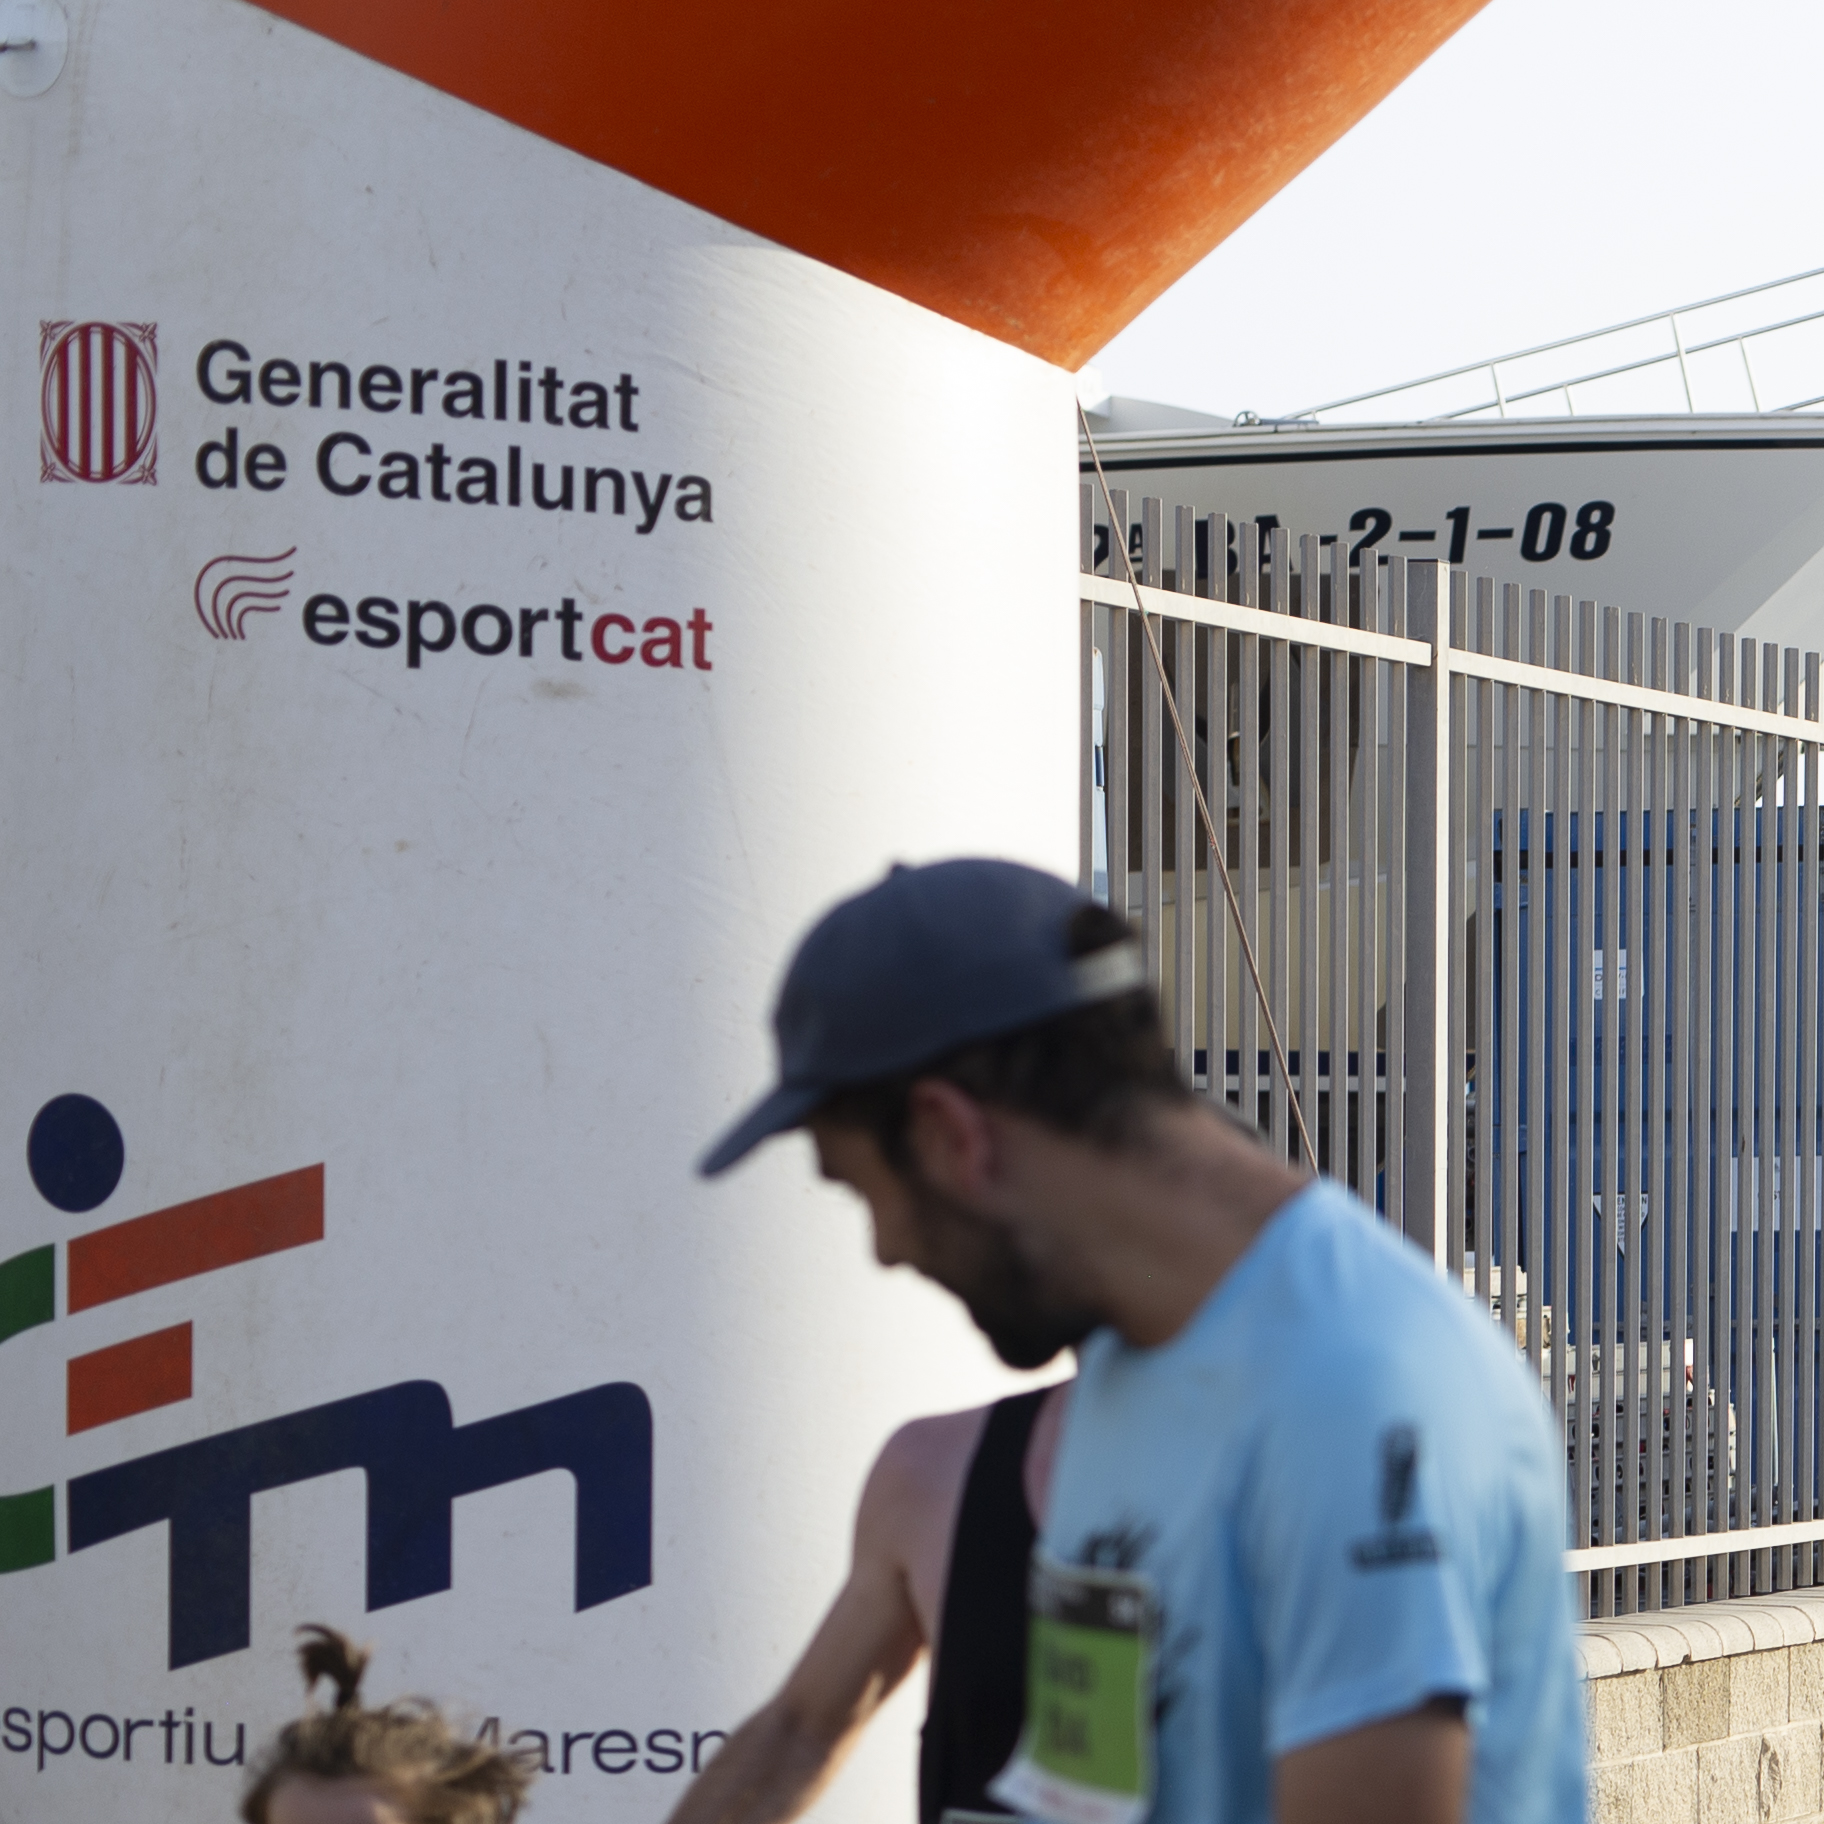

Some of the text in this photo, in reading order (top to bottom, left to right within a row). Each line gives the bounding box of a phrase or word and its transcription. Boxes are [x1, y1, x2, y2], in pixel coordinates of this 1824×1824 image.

[195, 338, 640, 434] Generalitat
[195, 427, 715, 535] de Catalunya
[302, 590, 715, 672] esportcat
[0, 1706, 246, 1773] sportiu
